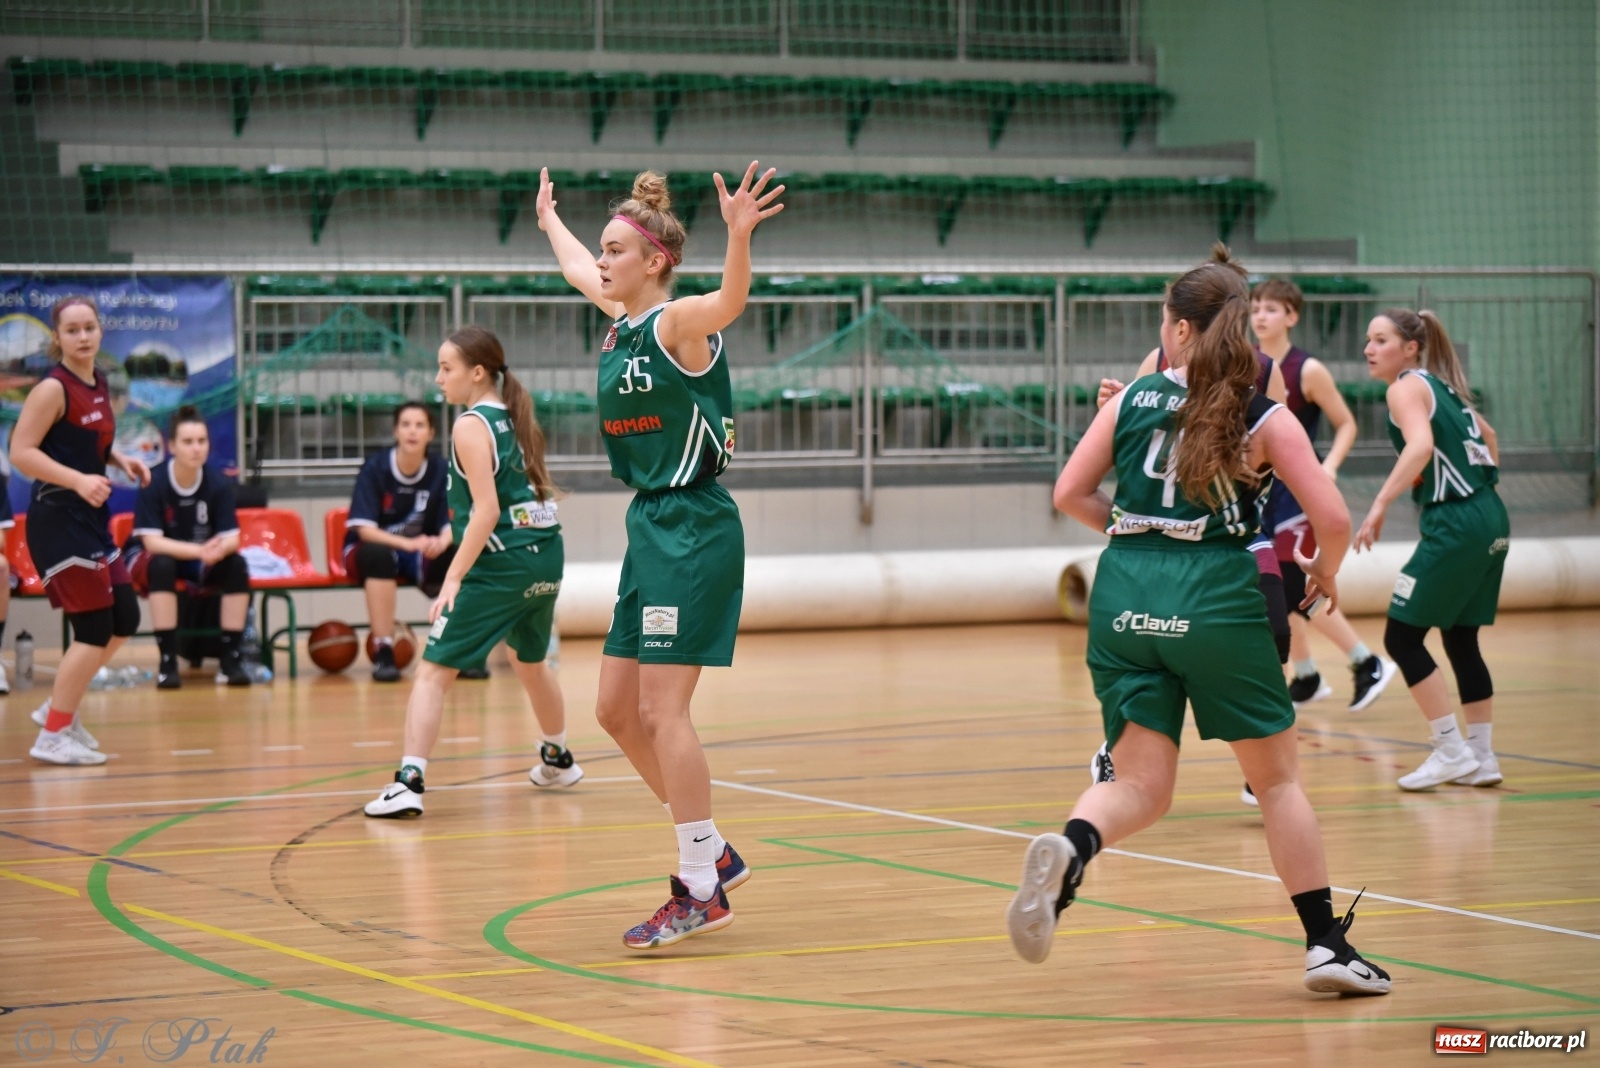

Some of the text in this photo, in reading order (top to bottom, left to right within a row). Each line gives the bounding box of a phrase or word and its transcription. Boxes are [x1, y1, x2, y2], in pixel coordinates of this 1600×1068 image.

[618, 355, 653, 395] 35
[604, 415, 662, 436] KAMAN
[1143, 429, 1184, 508] 4
[1130, 613, 1190, 633] Clavis
